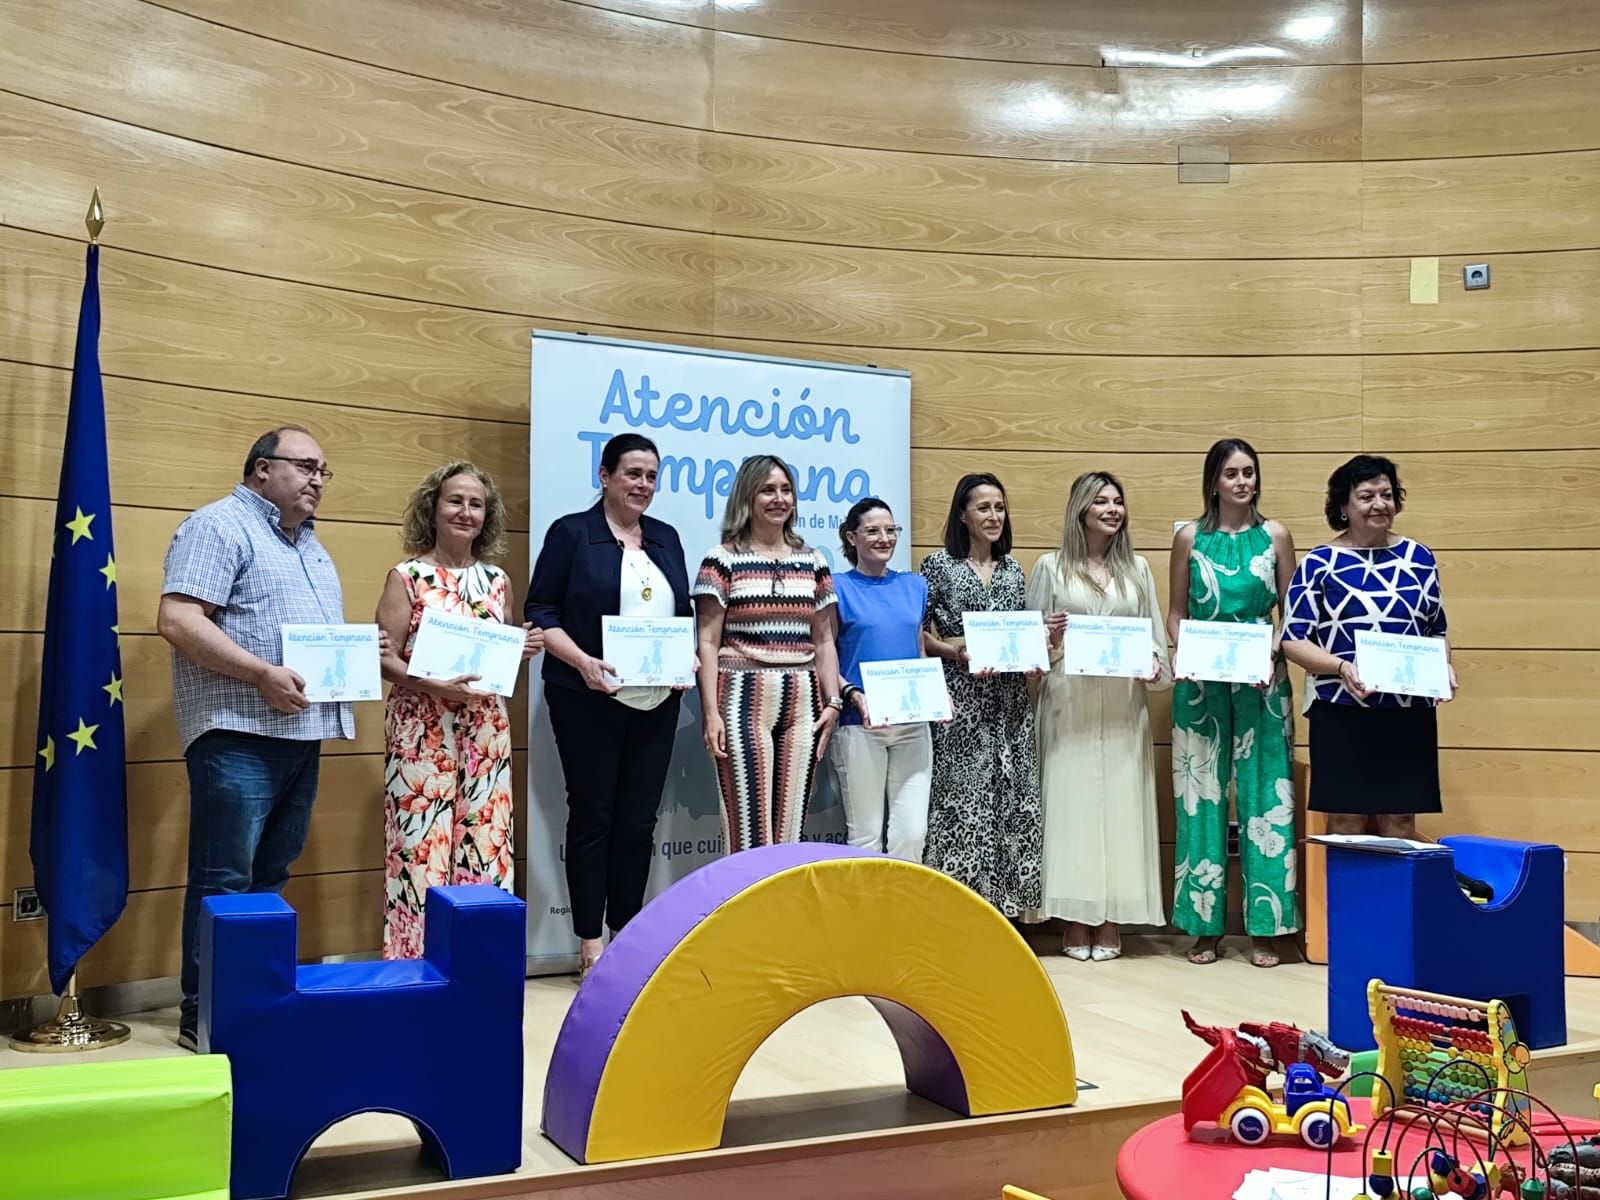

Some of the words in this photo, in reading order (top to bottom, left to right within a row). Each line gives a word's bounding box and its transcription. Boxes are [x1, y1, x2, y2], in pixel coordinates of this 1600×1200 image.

[600, 368, 860, 444] Atención
[809, 514, 825, 529] de
[288, 632, 327, 642] Atención
[329, 632, 372, 643] Temprana
[427, 617, 469, 633] Atención
[473, 626, 519, 644] Temprana
[608, 624, 645, 633] Atención
[647, 624, 688, 635] Temprana
[661, 840, 692, 860] que
